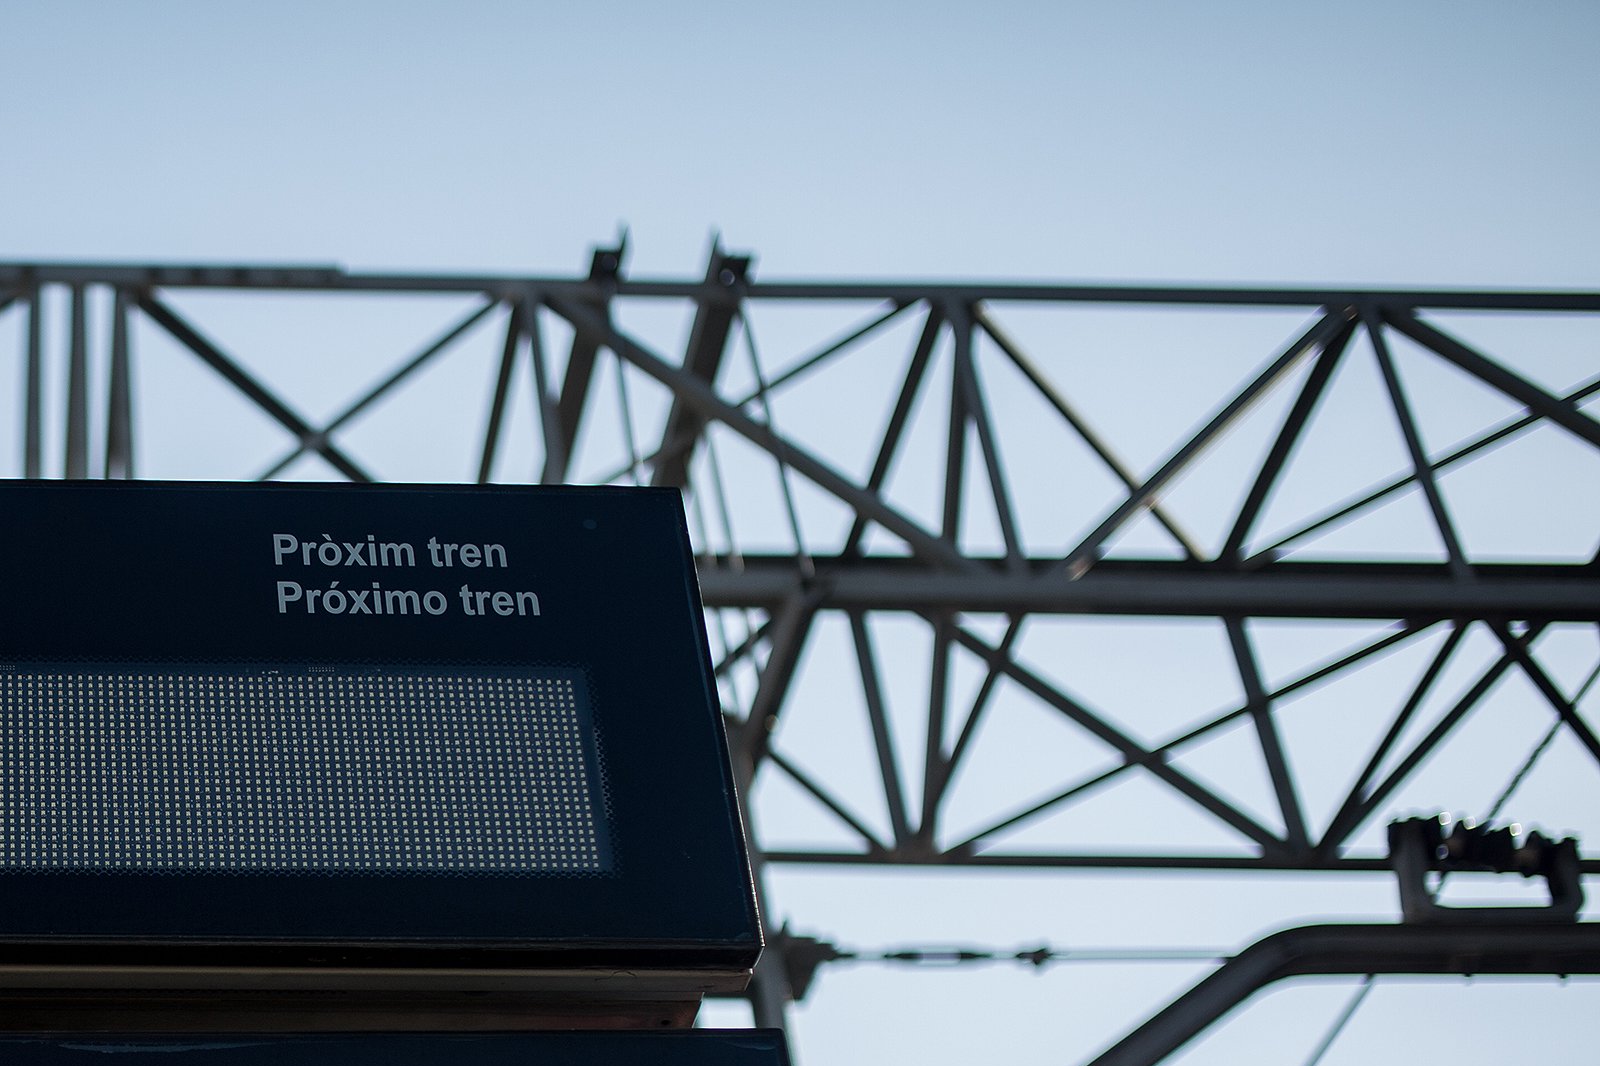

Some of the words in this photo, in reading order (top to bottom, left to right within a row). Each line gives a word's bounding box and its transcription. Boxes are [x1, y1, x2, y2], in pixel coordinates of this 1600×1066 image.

[272, 533, 417, 569] Pròxim
[427, 537, 510, 569] tren
[276, 581, 449, 618] Próximo
[458, 585, 543, 618] tren
